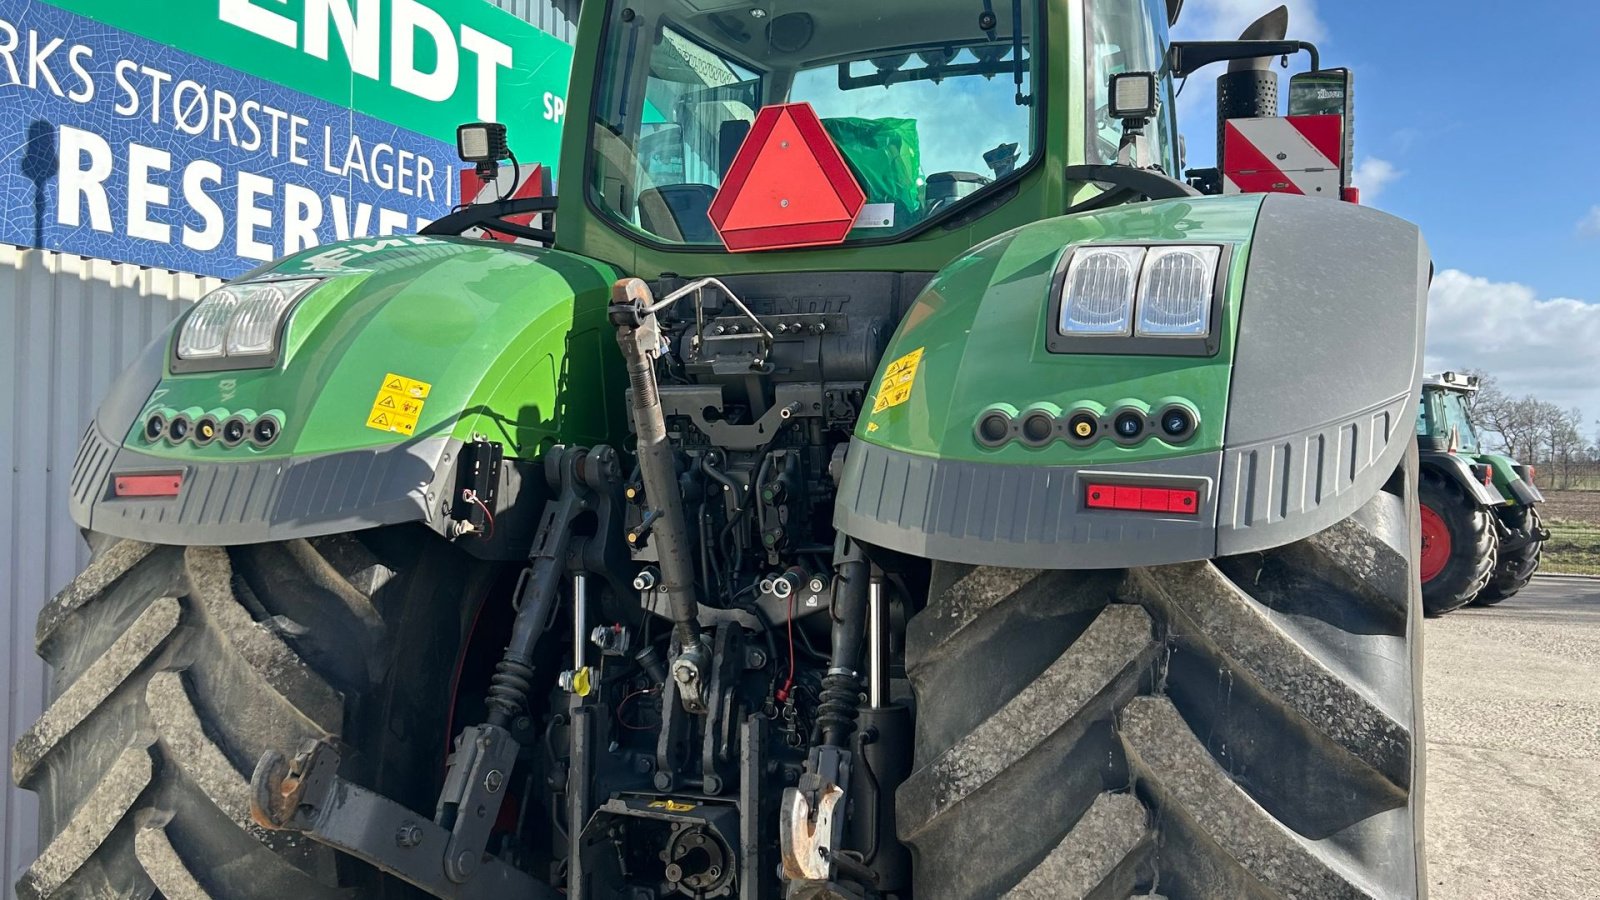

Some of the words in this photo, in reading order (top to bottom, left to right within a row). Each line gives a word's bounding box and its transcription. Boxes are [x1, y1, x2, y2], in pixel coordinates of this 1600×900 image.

[0, 19, 95, 104] RKS
[115, 59, 309, 167] STØRSTE
[324, 125, 436, 202] LAGER
[446, 164, 453, 207] I
